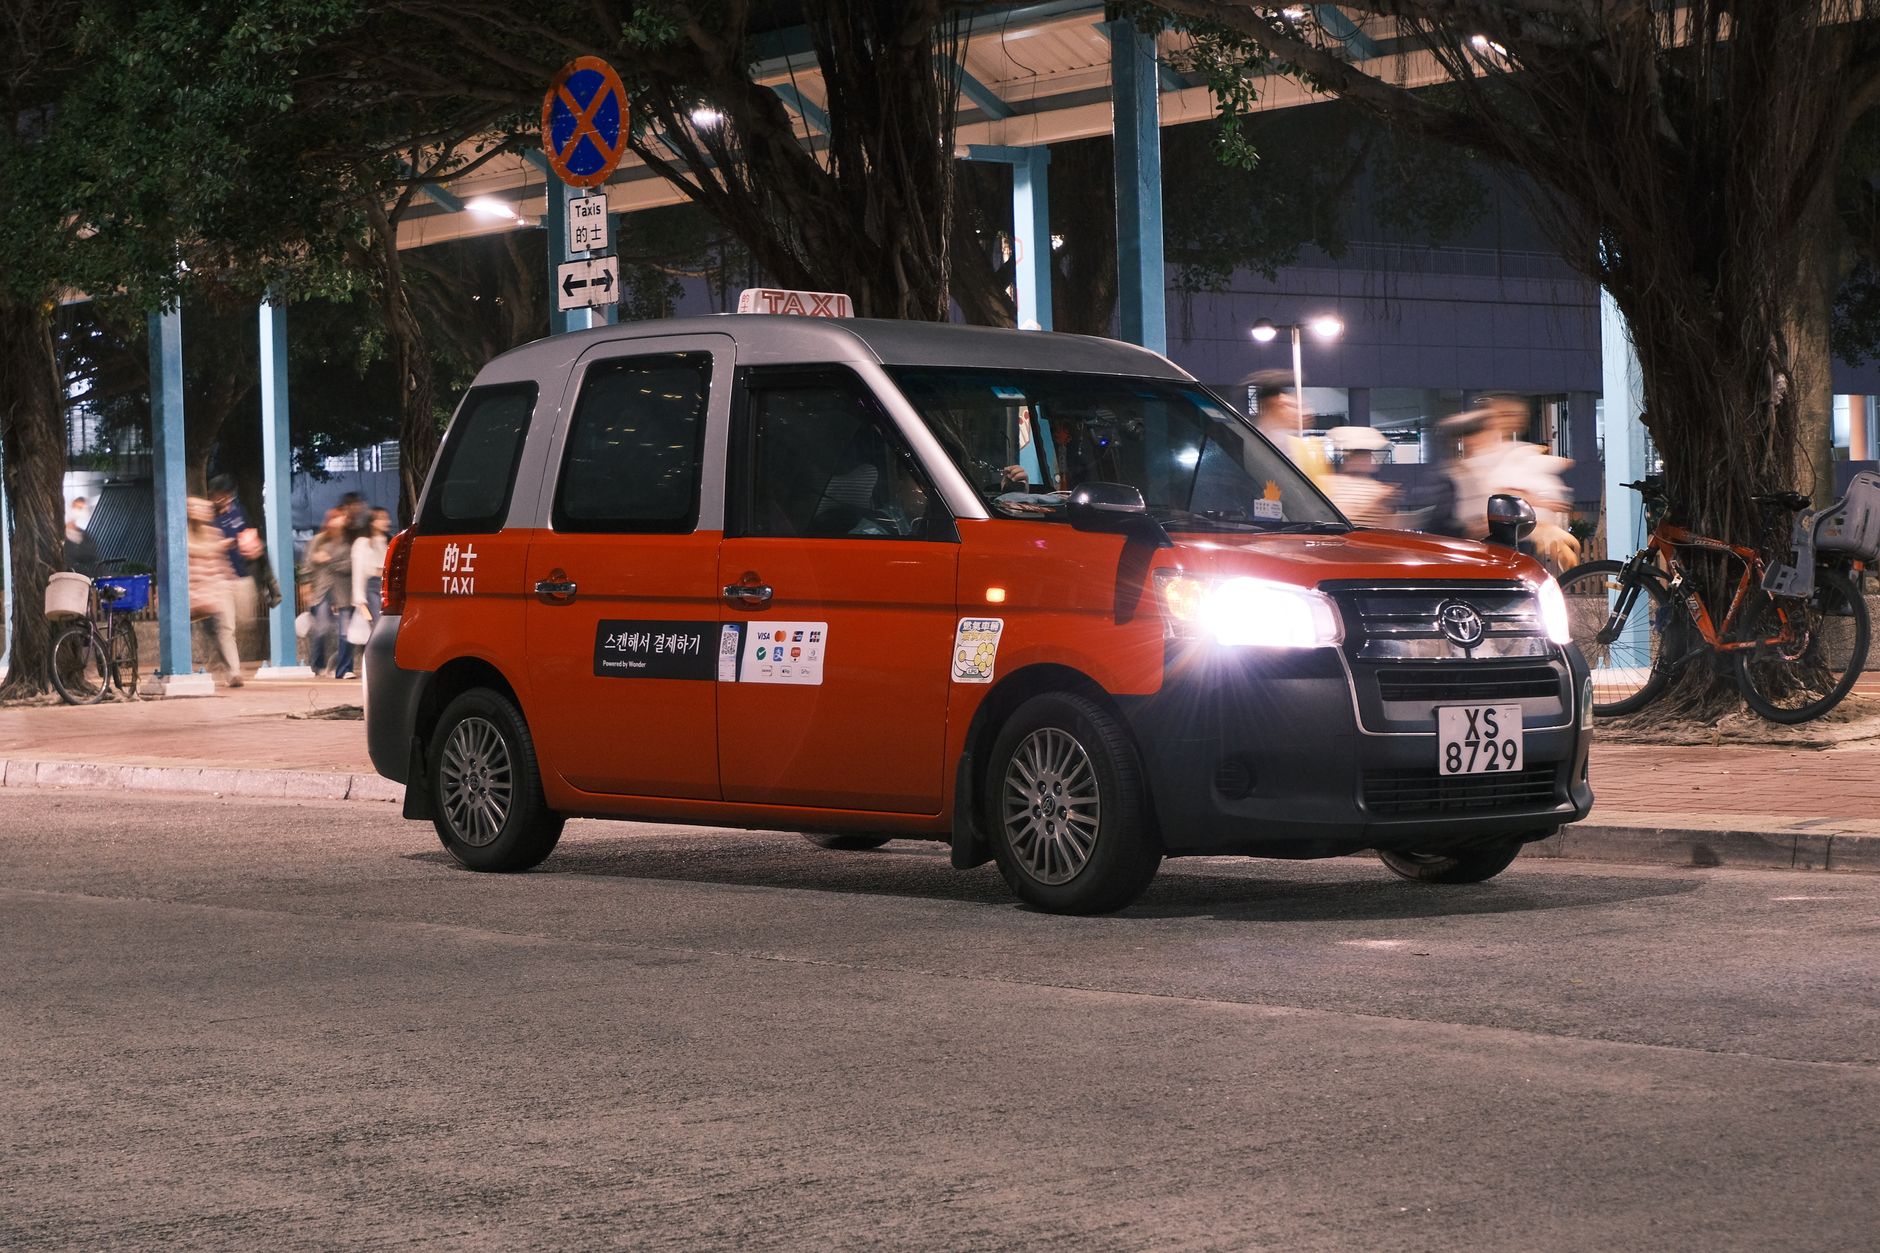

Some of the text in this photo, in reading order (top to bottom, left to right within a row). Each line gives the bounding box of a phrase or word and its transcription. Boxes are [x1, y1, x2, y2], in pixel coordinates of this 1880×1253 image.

[575, 203, 601, 217] Taxis
[576, 224, 602, 243] 的士
[762, 290, 846, 318] TAXI
[442, 543, 477, 572] 的士
[442, 576, 474, 595] TAXI
[604, 632, 701, 655] 스캔해서 결제하기
[757, 632, 770, 640] VISA
[622, 661, 628, 669] by
[1465, 708, 1499, 740] XS
[1446, 739, 1518, 773] 8729
